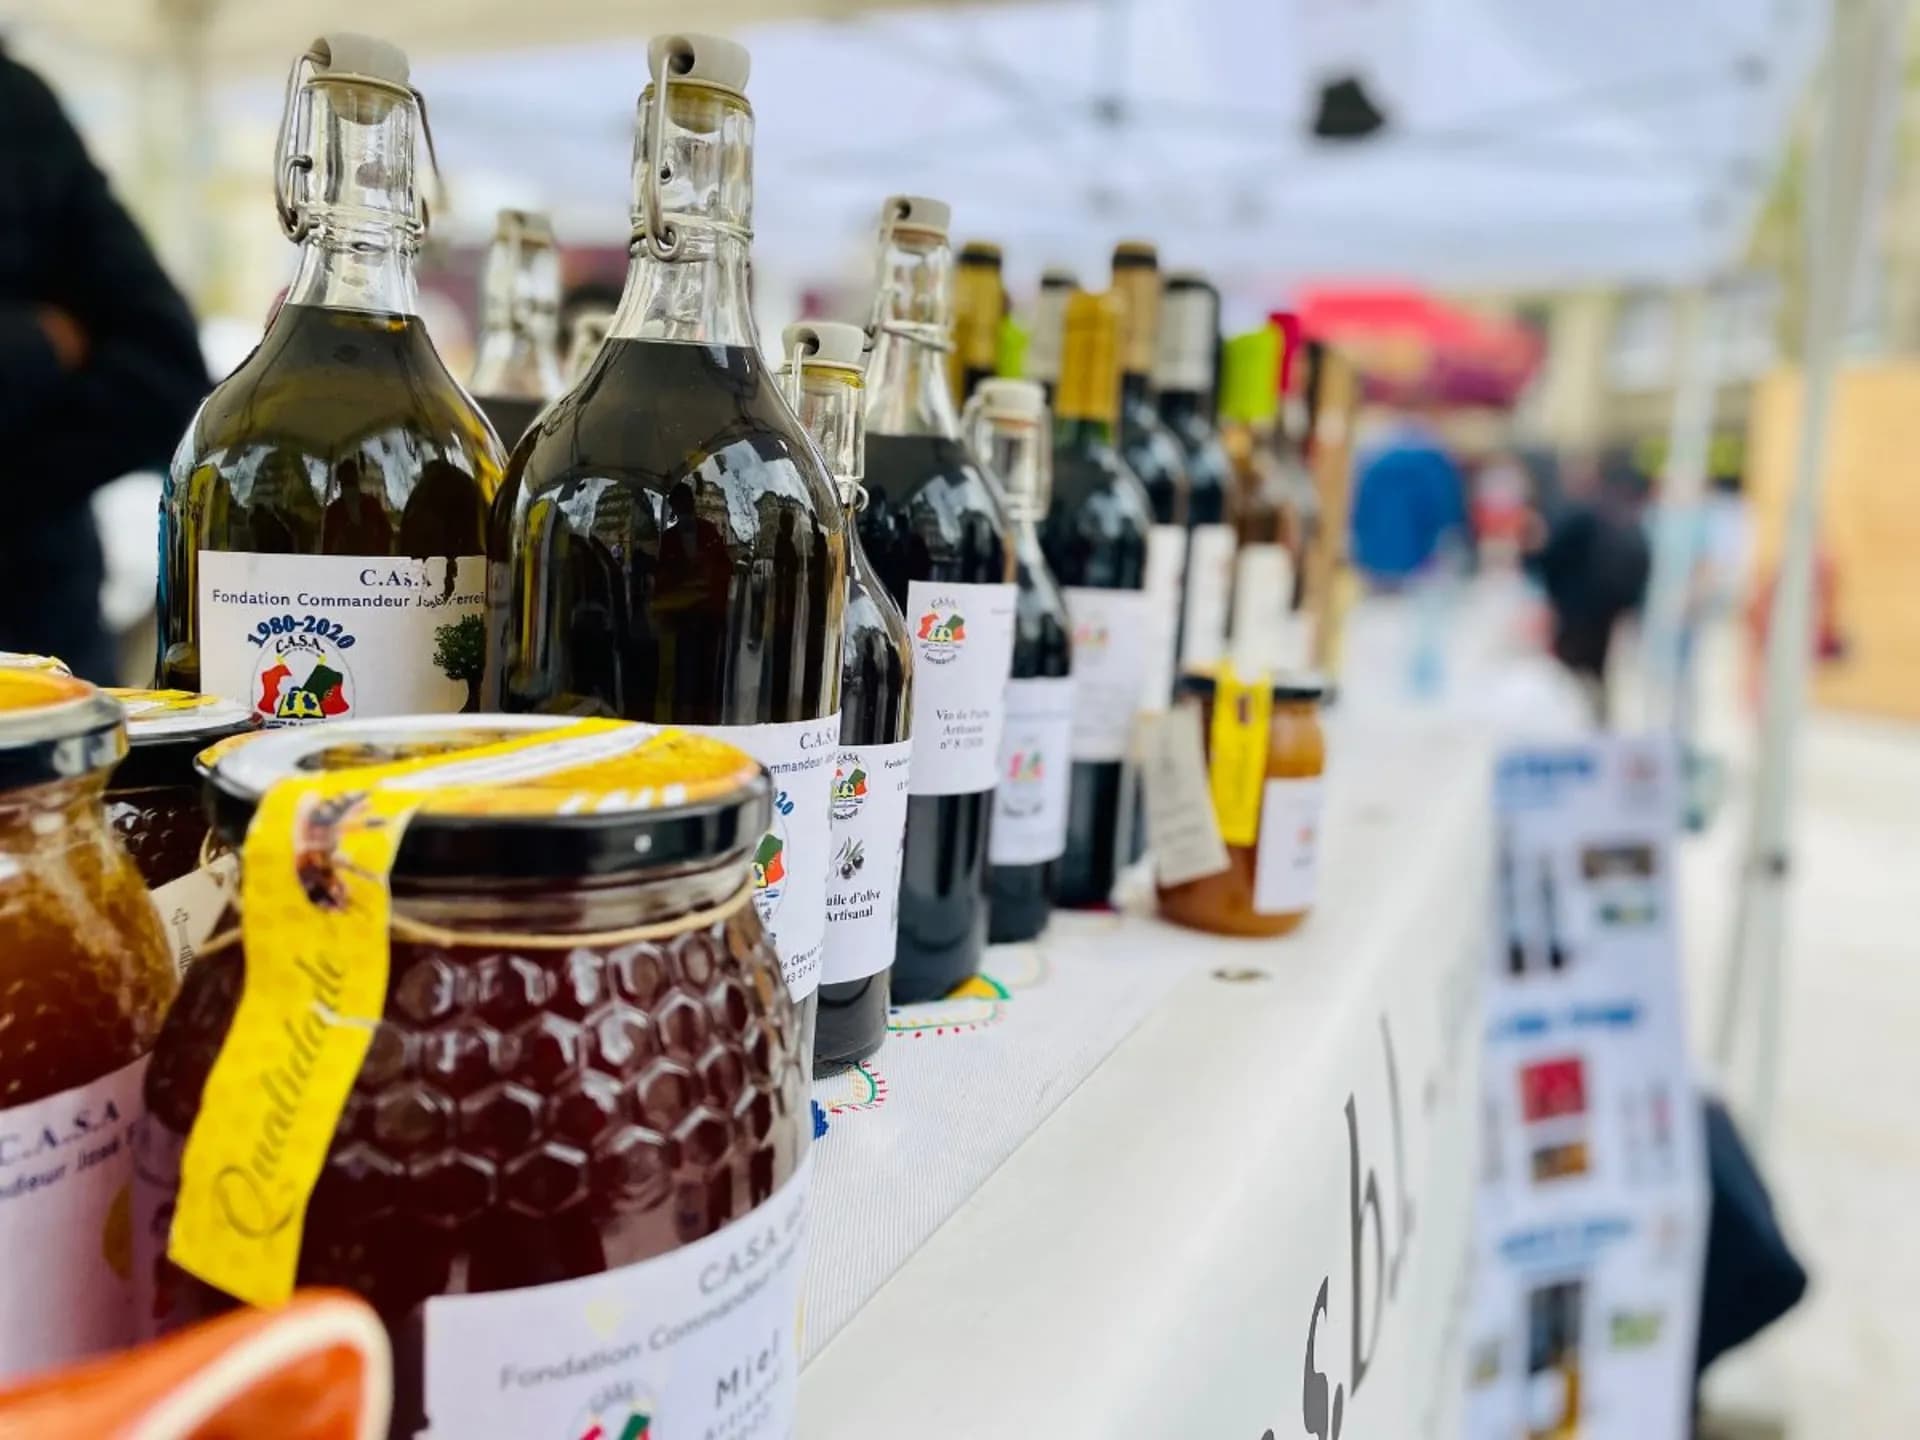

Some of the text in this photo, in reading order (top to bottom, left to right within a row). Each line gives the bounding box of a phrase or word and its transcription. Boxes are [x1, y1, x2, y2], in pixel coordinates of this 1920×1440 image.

[212, 589, 290, 605] Fondation
[297, 592, 410, 607] Commandeur
[247, 614, 356, 649] 1980-2020
[498, 1341, 642, 1392] Fondation
